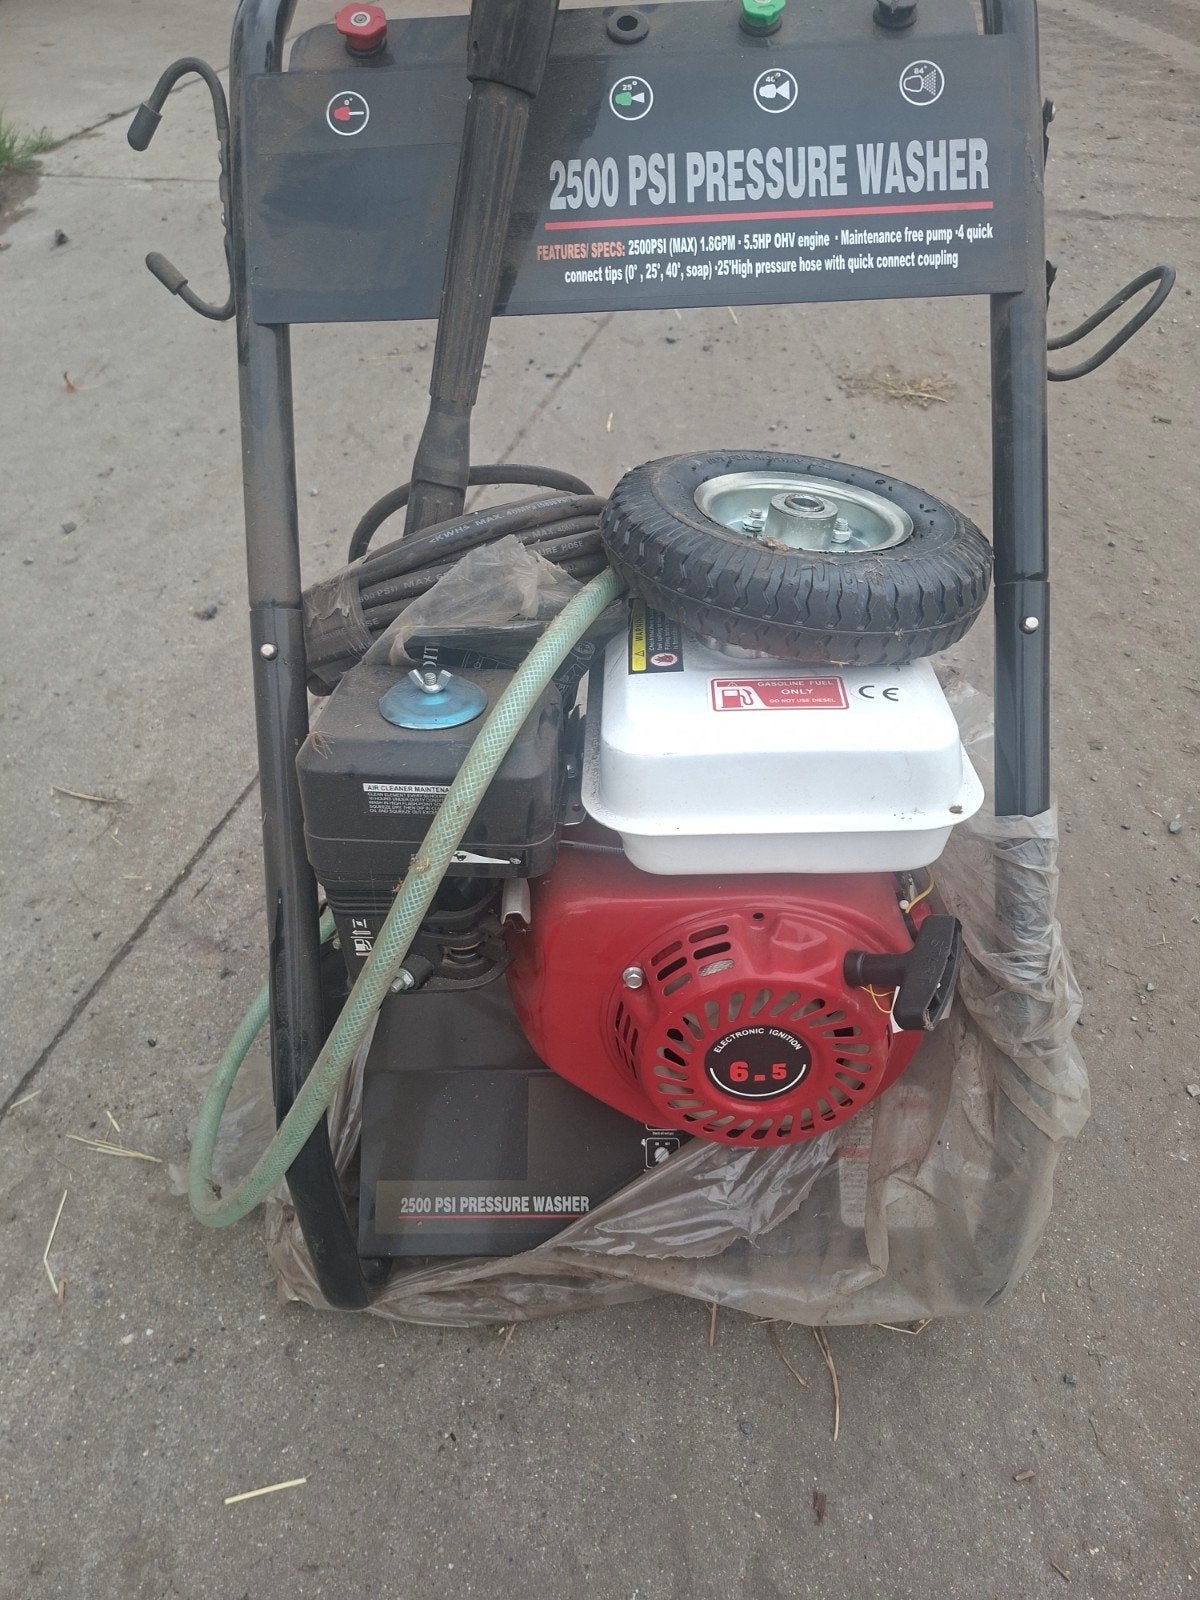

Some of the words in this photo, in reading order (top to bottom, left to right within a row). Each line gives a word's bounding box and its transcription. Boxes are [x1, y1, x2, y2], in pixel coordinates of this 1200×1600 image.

[549, 157, 619, 210] 2500
[628, 152, 676, 206] PSI
[686, 144, 848, 203] PRESSURE
[856, 137, 990, 195] WASHER
[591, 241, 626, 258] SPECS:
[628, 238, 667, 256] 2500PSI
[669, 236, 698, 257] (MAX)
[700, 235, 736, 252] 1.8GPM
[743, 233, 772, 250] 5.5HP
[774, 232, 796, 249] OHV
[797, 231, 830, 251] engine
[840, 229, 902, 245] Maintenance
[904, 226, 924, 242] free
[926, 228, 953, 245] pump
[966, 222, 994, 243] quick
[564, 266, 603, 283] connect
[604, 265, 623, 284] tips
[686, 260, 713, 280] soap)
[755, 260, 797, 278] pressure
[799, 256, 822, 272] hose
[824, 254, 846, 270] with
[847, 253, 874, 273] quick
[876, 251, 915, 269] connect
[917, 249, 959, 269] coupling
[635, 614, 644, 642] WARNIN
[858, 685, 899, 701] CE
[713, 1027, 765, 1053] ELECTRONIC
[769, 1028, 802, 1051] IGNITION
[400, 1197, 432, 1213] 2500
[434, 1197, 456, 1213] PSI
[460, 1195, 529, 1213] PRESSURE
[533, 1195, 590, 1212] WASHER
